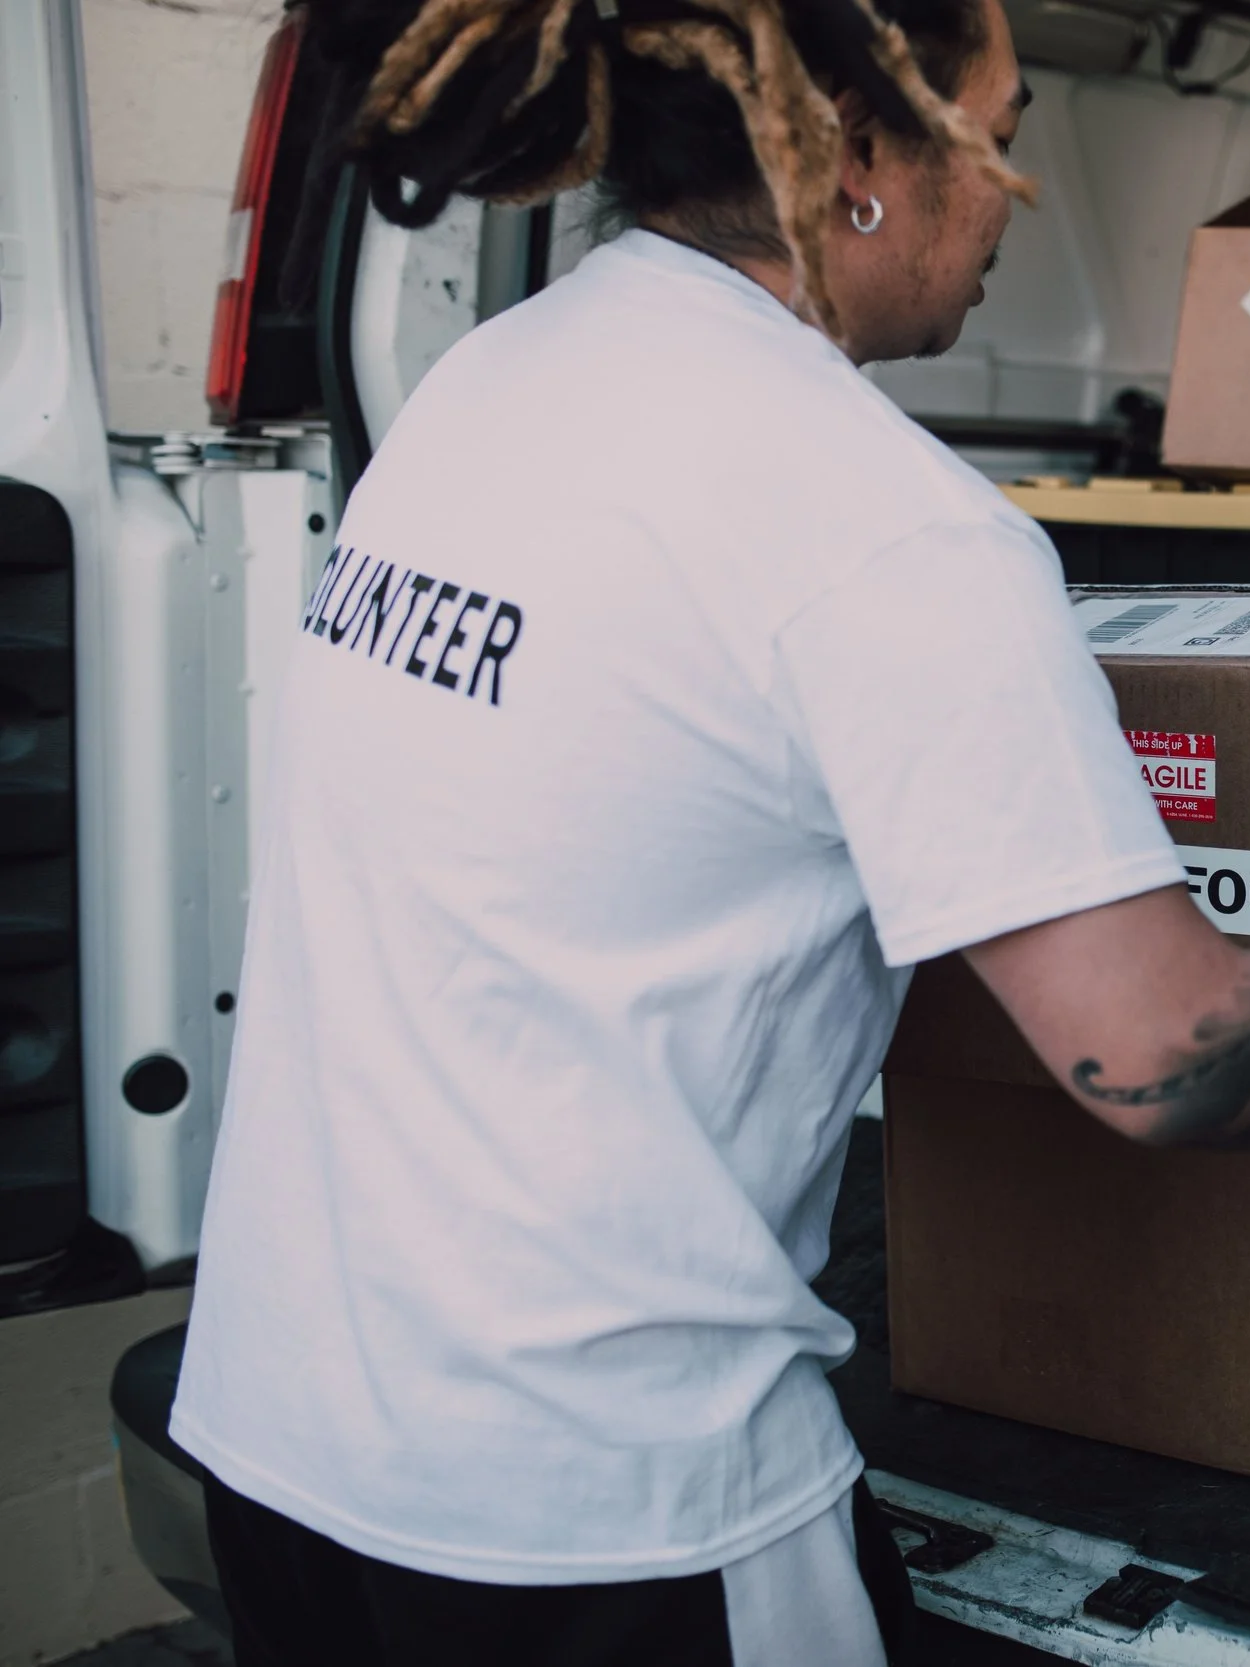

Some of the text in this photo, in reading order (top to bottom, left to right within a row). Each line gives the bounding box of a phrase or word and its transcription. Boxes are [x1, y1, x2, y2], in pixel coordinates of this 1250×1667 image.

[303, 544, 522, 706] OLUNTEER
[1132, 739, 1182, 750] THIS SIDE UP
[1141, 764, 1206, 790] AGILE
[1174, 801, 1197, 810] CARE
